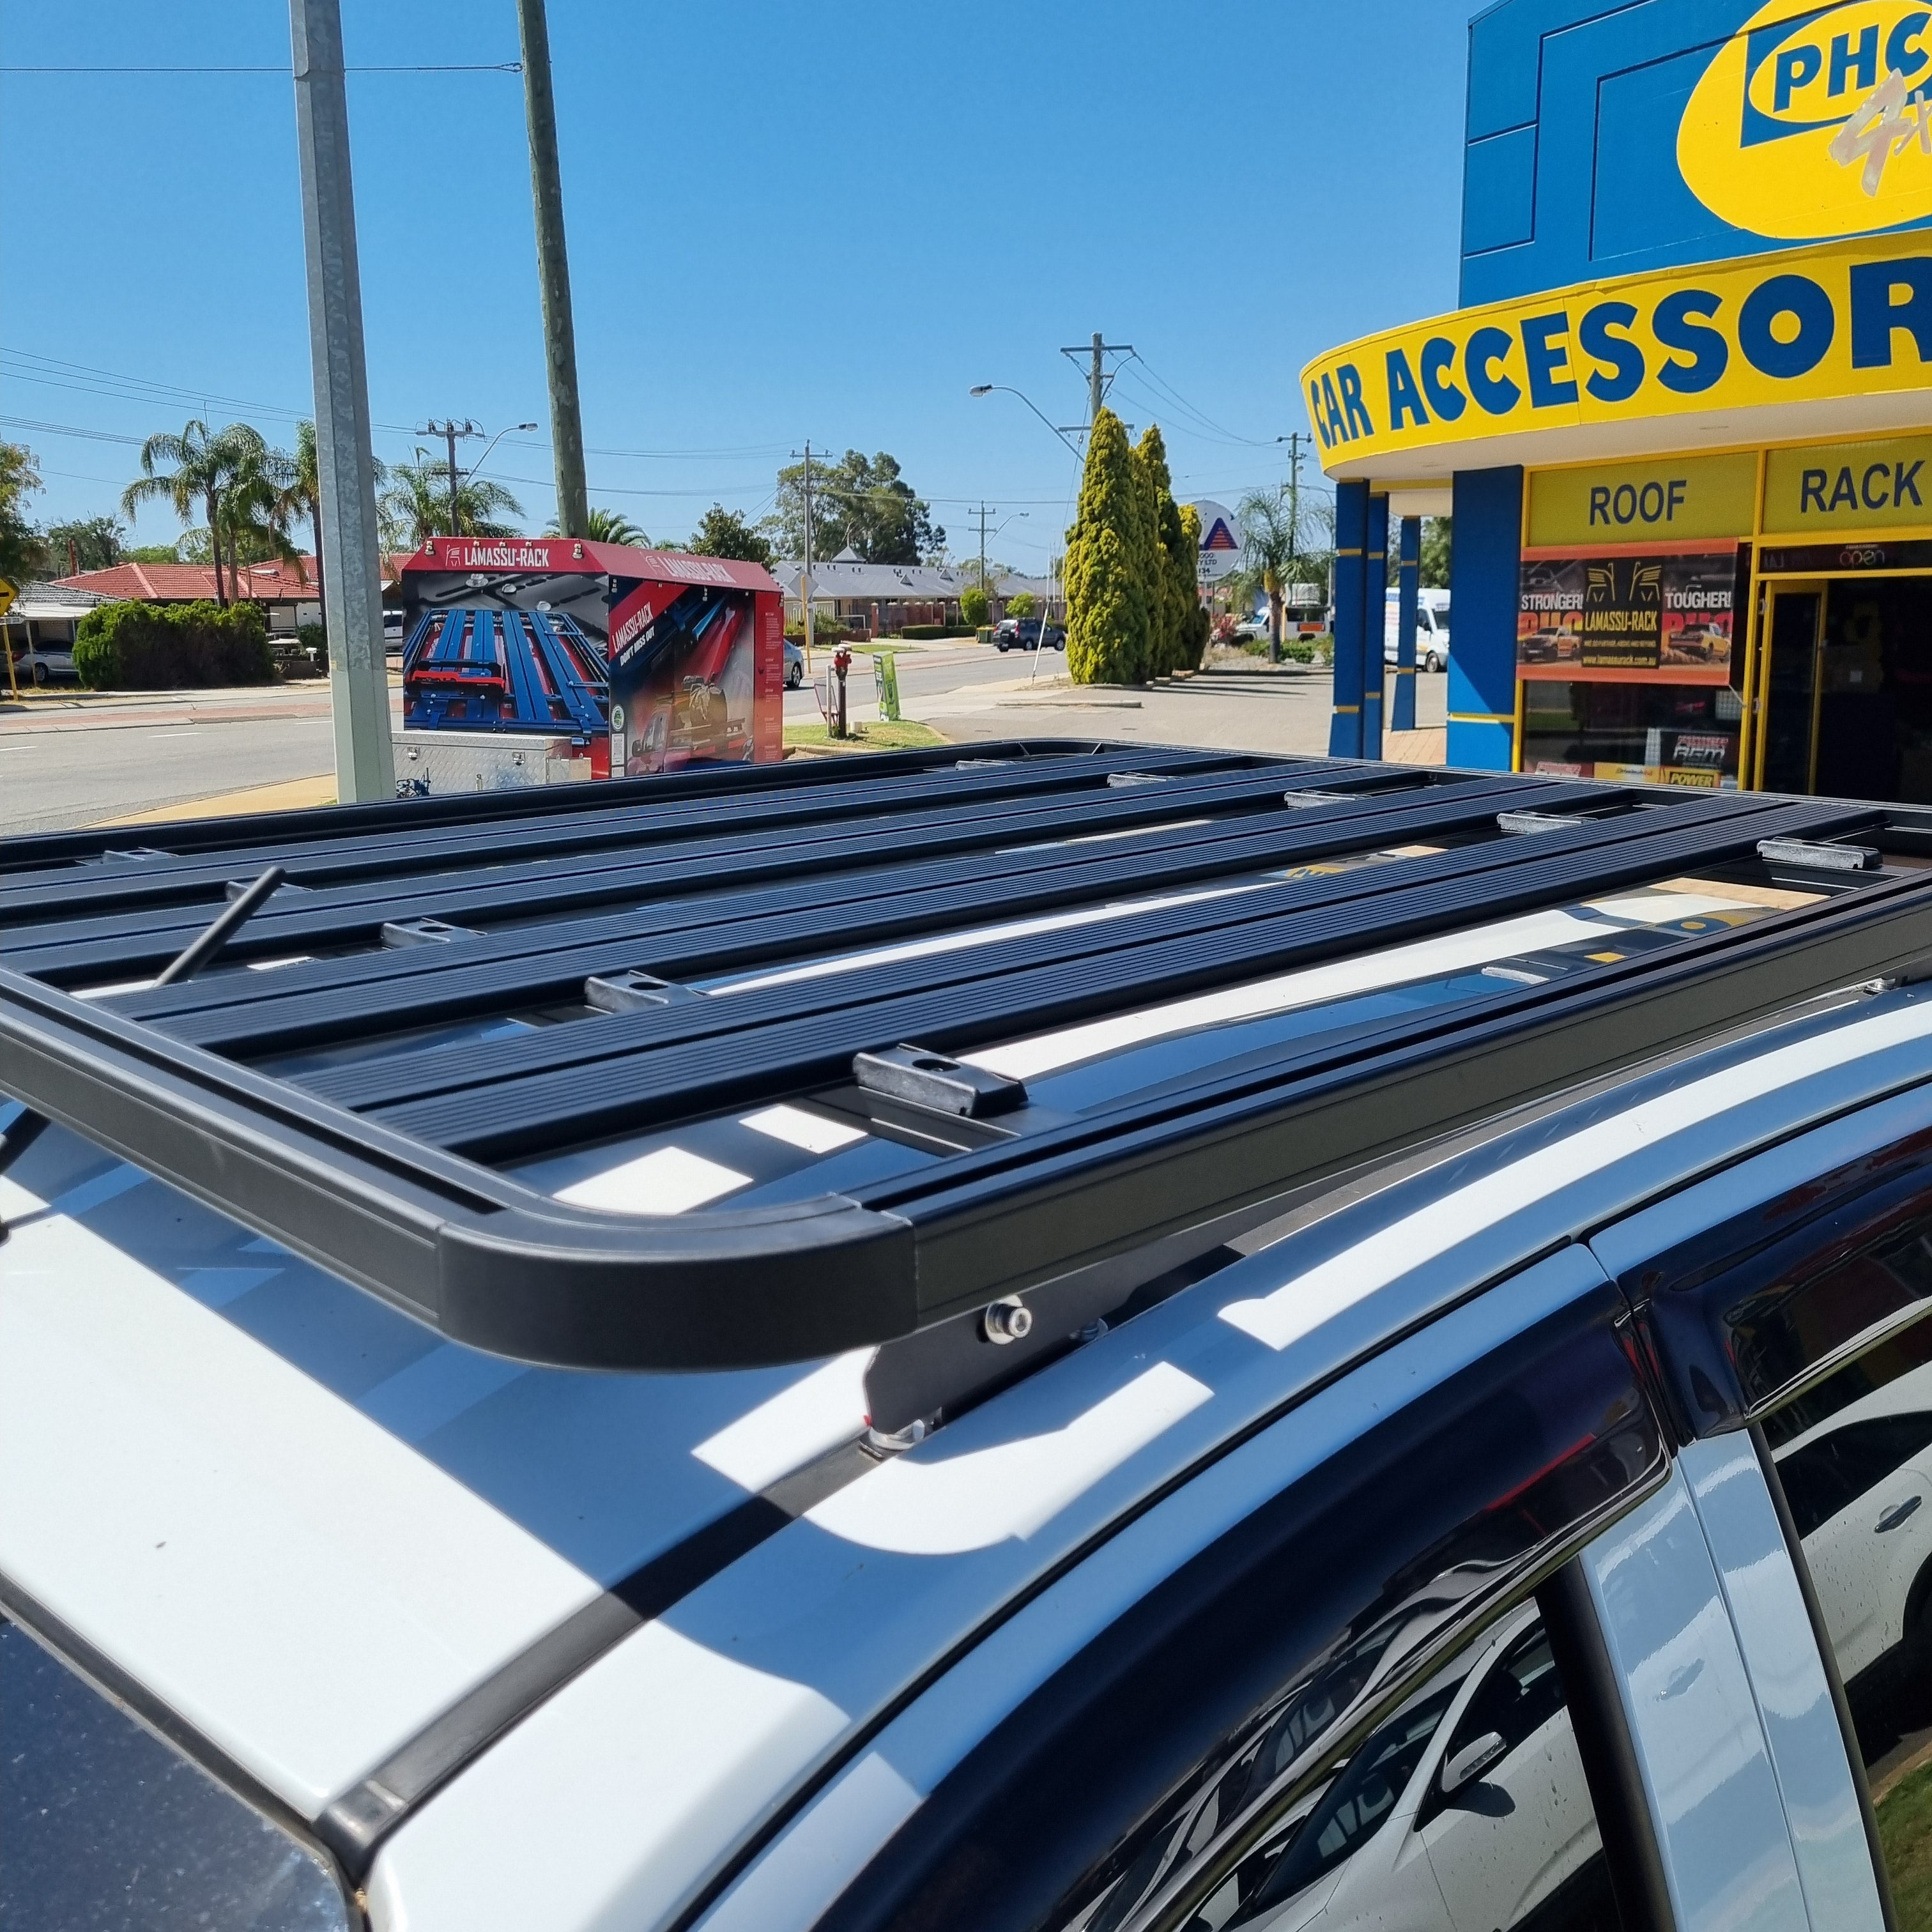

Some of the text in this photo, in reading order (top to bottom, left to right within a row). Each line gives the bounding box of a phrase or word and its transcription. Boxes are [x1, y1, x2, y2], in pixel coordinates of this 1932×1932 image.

[1773, 12, 1932, 113] PHC
[1310, 257, 1932, 449] CAR ACCESSOR
[1590, 480, 1687, 526] ROOF
[1800, 459, 1926, 514] RACK
[464, 547, 549, 567] LAMASSU-RACK
[1521, 594, 1584, 610] STRONGER!
[1584, 610, 1657, 632] LAMASSU-RACK
[1665, 591, 1731, 609] TOUGHER!
[611, 601, 654, 654] LAMASSU-RACK
[620, 625, 655, 667] DON'T MISS OUT
[1670, 772, 1713, 787] POWER
